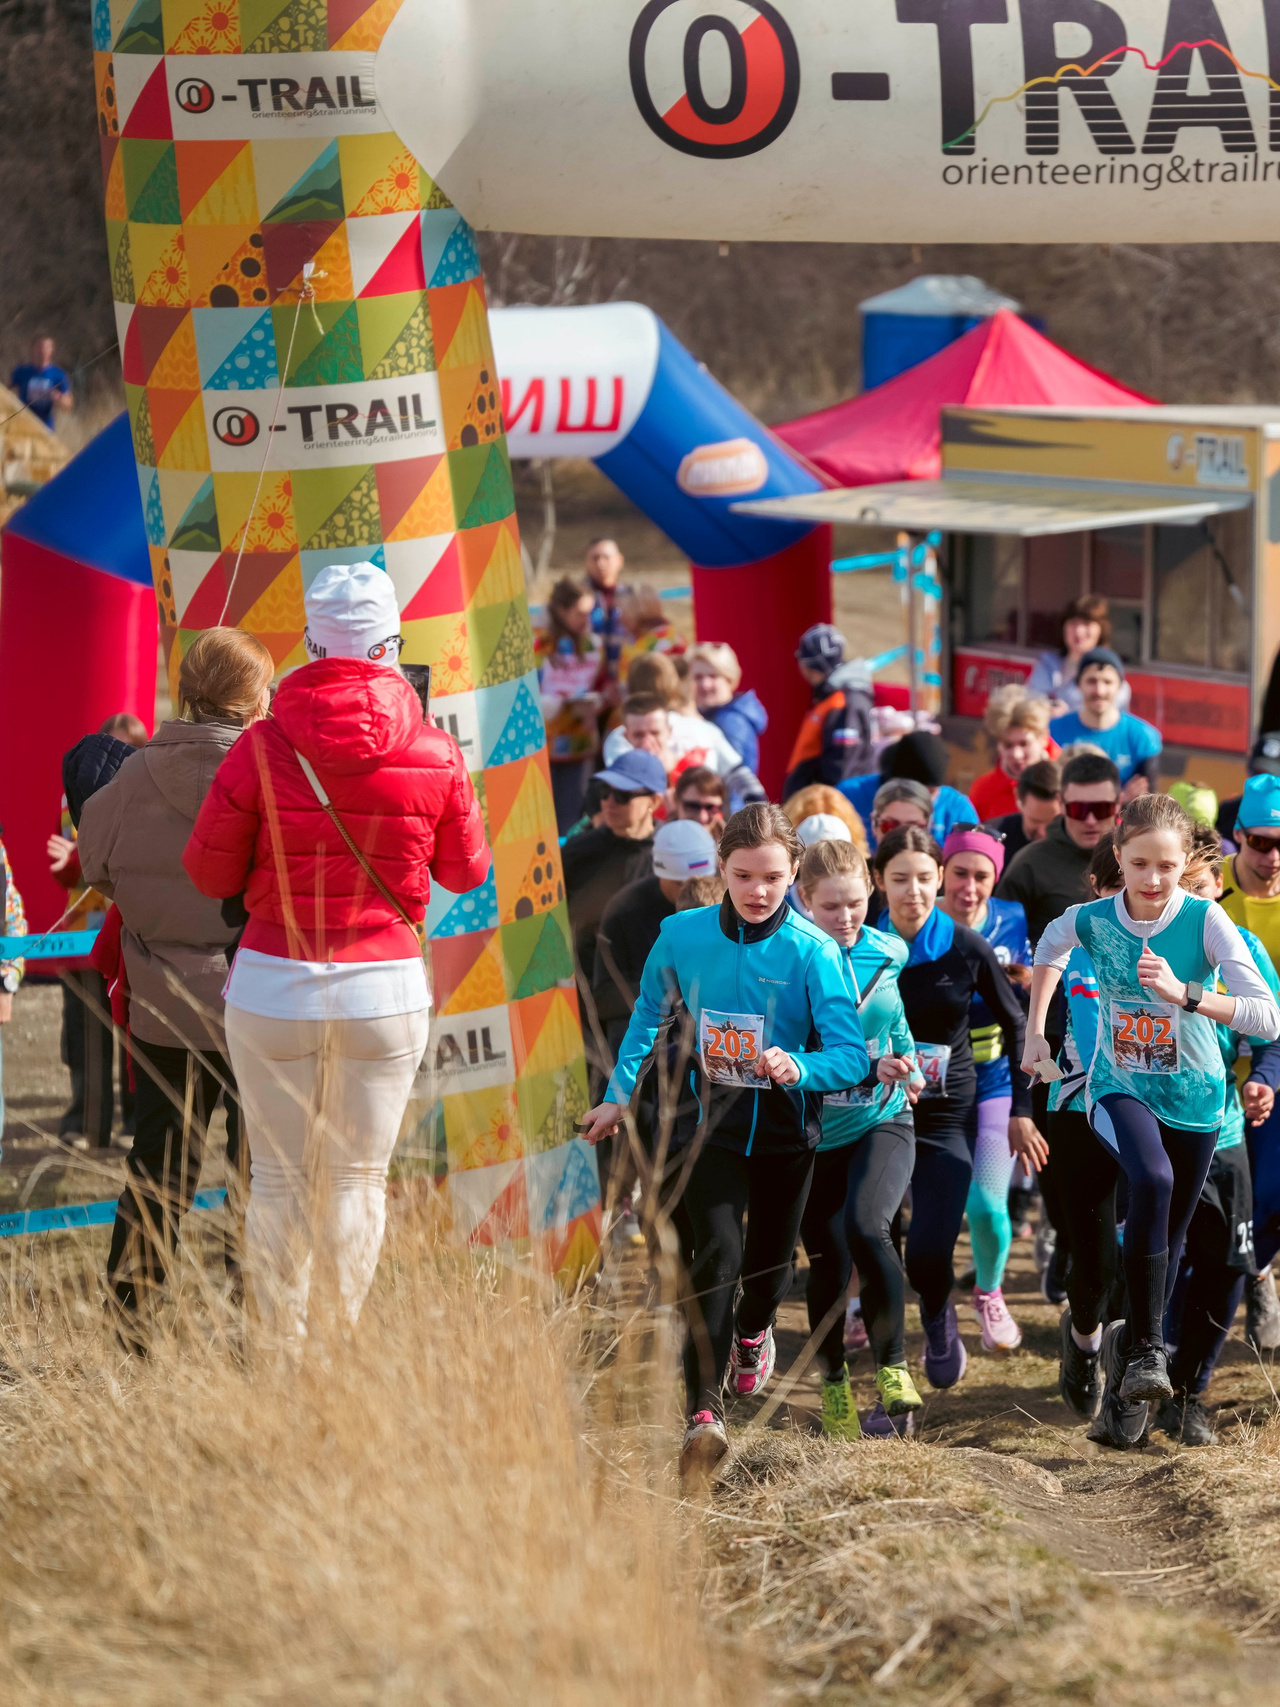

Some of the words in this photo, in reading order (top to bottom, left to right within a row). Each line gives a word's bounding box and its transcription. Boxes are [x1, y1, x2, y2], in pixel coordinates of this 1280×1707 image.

[500, 377, 624, 433] ИШ
[303, 427, 438, 450] orienteering&trailrunning
[706, 1027, 758, 1060] 203
[1117, 1013, 1173, 1044] 202
